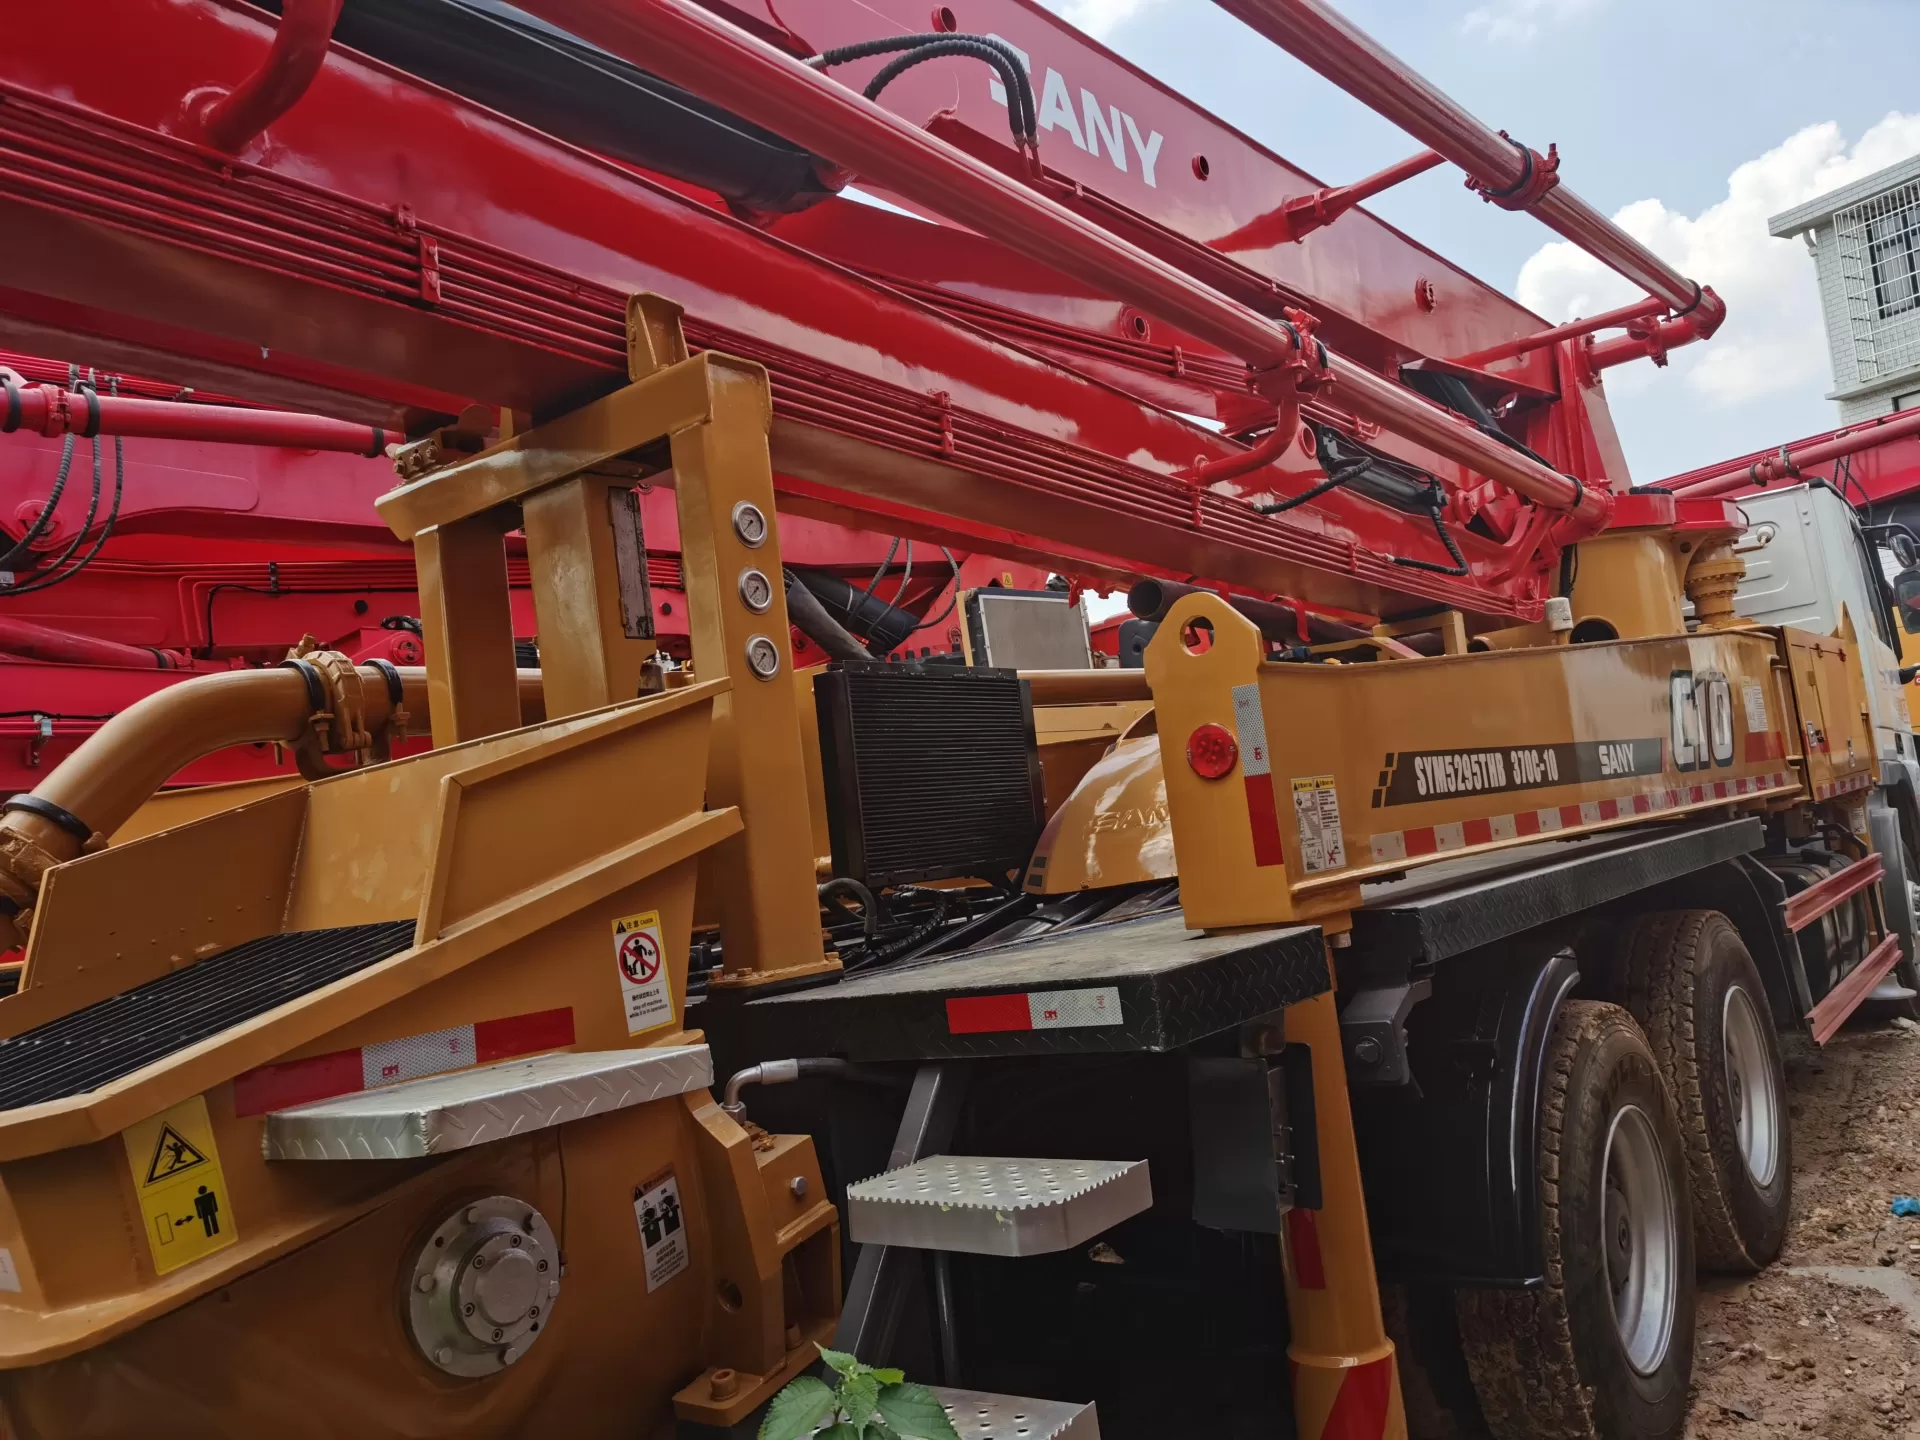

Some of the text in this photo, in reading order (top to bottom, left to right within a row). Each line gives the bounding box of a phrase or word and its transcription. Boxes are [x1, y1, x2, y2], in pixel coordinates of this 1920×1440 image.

[1414, 748, 1559, 796] SYM5295THB 370C-10
[1598, 743, 1635, 775] SANY
